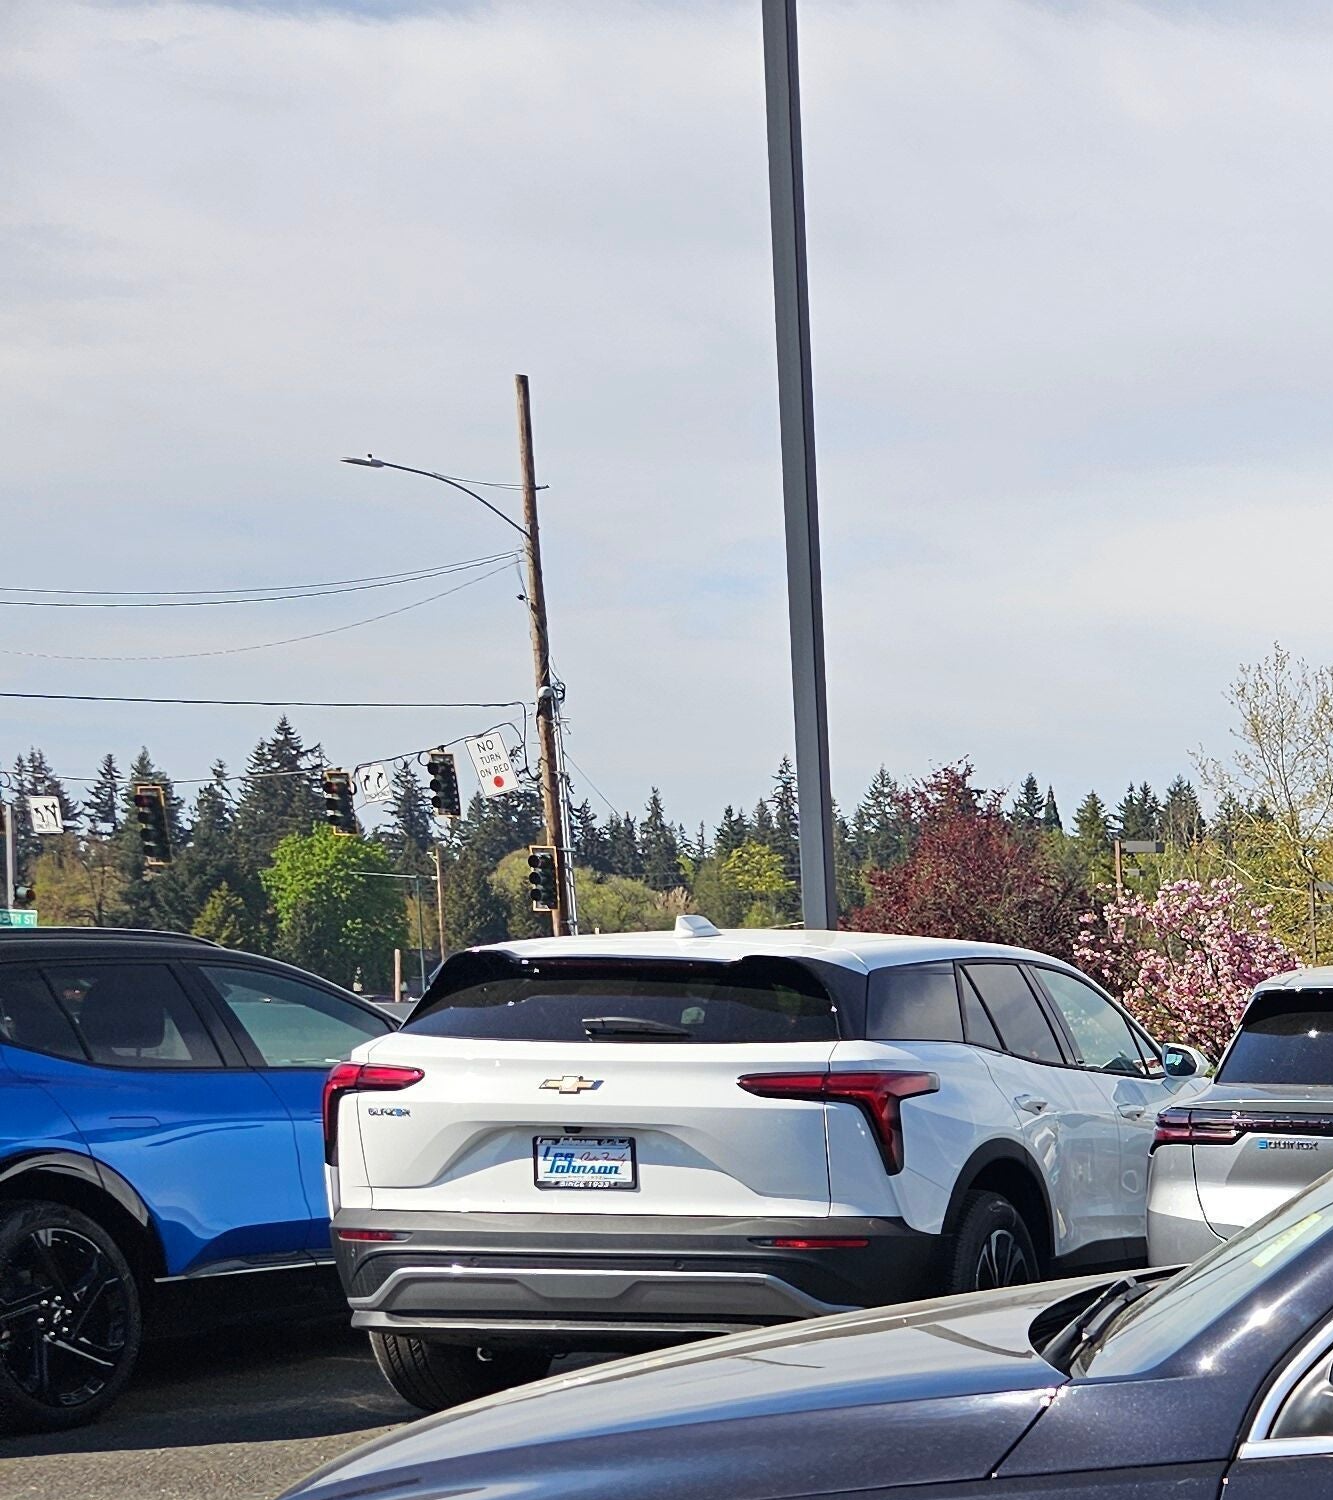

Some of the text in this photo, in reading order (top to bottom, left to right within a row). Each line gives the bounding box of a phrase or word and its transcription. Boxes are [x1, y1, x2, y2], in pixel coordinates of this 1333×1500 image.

[476, 739, 494, 753] NO
[479, 752, 502, 765] TURN
[479, 762, 510, 778] ON RED
[23, 914, 35, 925] ST
[543, 1146, 575, 1161] Lee
[544, 1159, 622, 1175] Johnson
